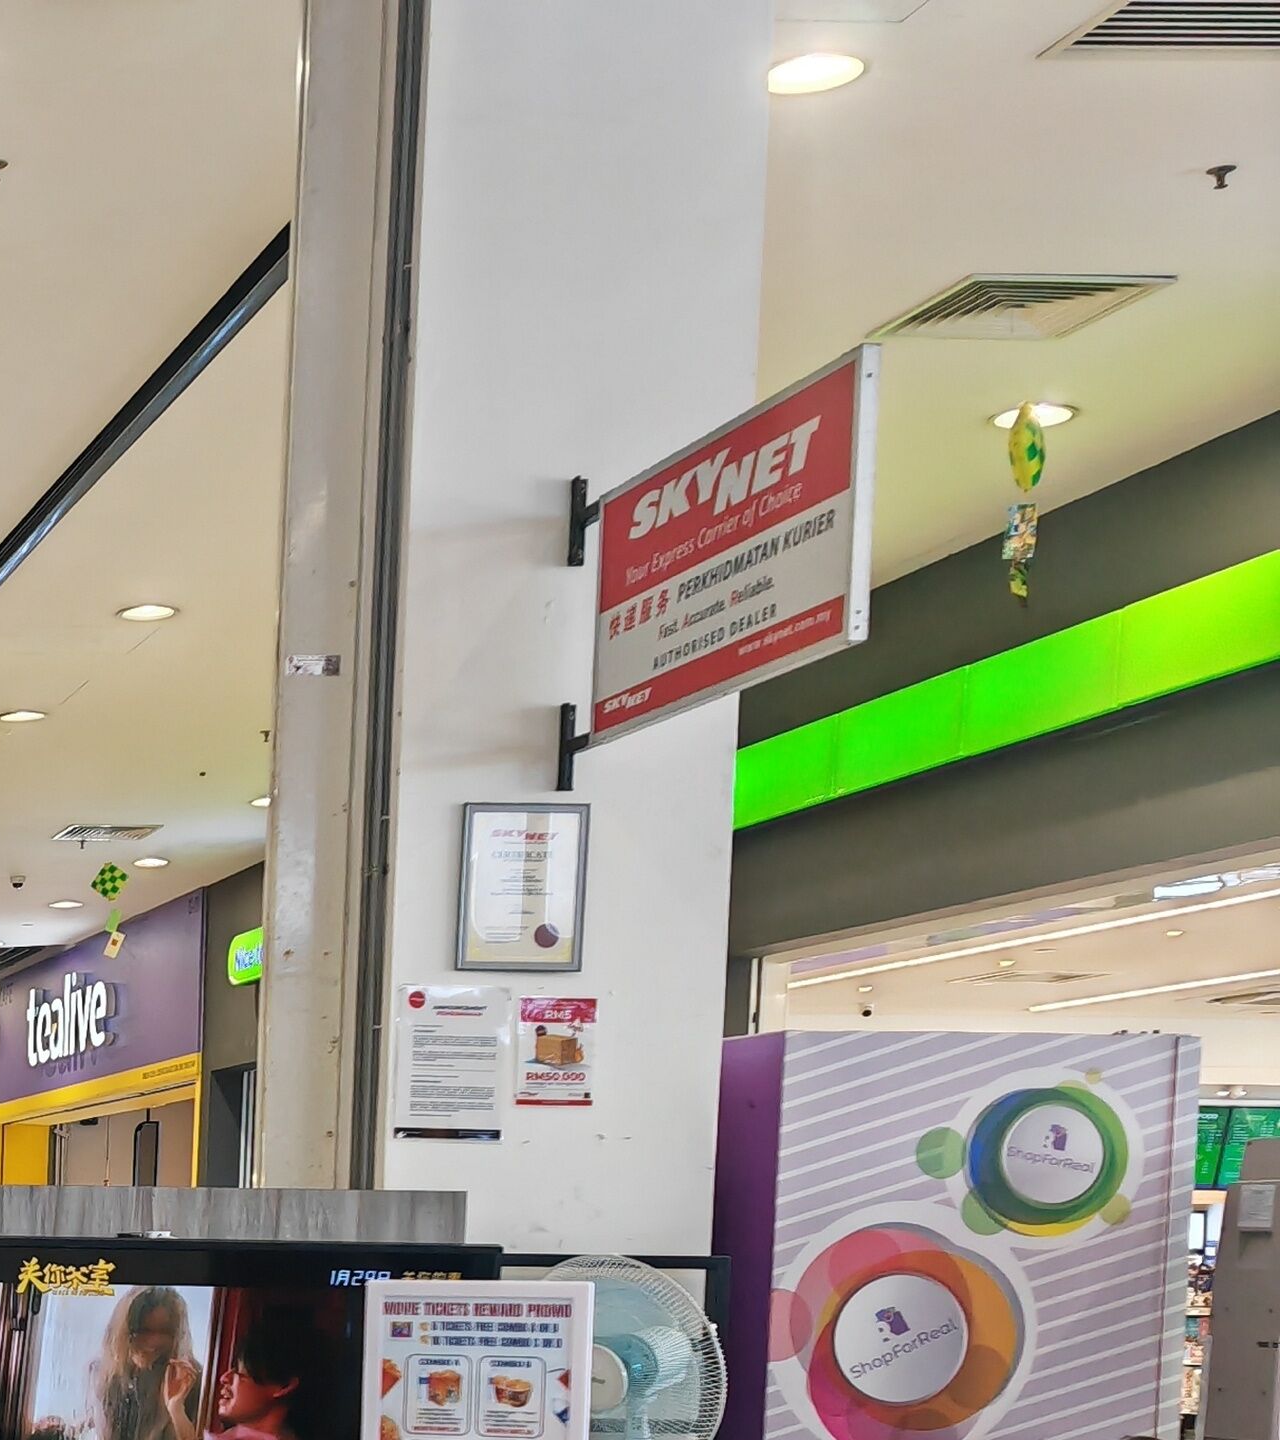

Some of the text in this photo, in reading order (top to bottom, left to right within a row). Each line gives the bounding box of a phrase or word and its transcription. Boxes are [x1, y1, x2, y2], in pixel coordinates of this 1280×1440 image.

[627, 415, 822, 540] SKYNET
[650, 537, 695, 577] Express
[695, 512, 742, 552] Carrier
[742, 503, 755, 531] of
[757, 480, 804, 518] Choice
[675, 508, 836, 604] PERKHIDMATAN KURIER
[652, 602, 778, 671] AUTHORISED DEALER
[26, 972, 107, 1067] tealive
[849, 1318, 960, 1379] ShopForReal
